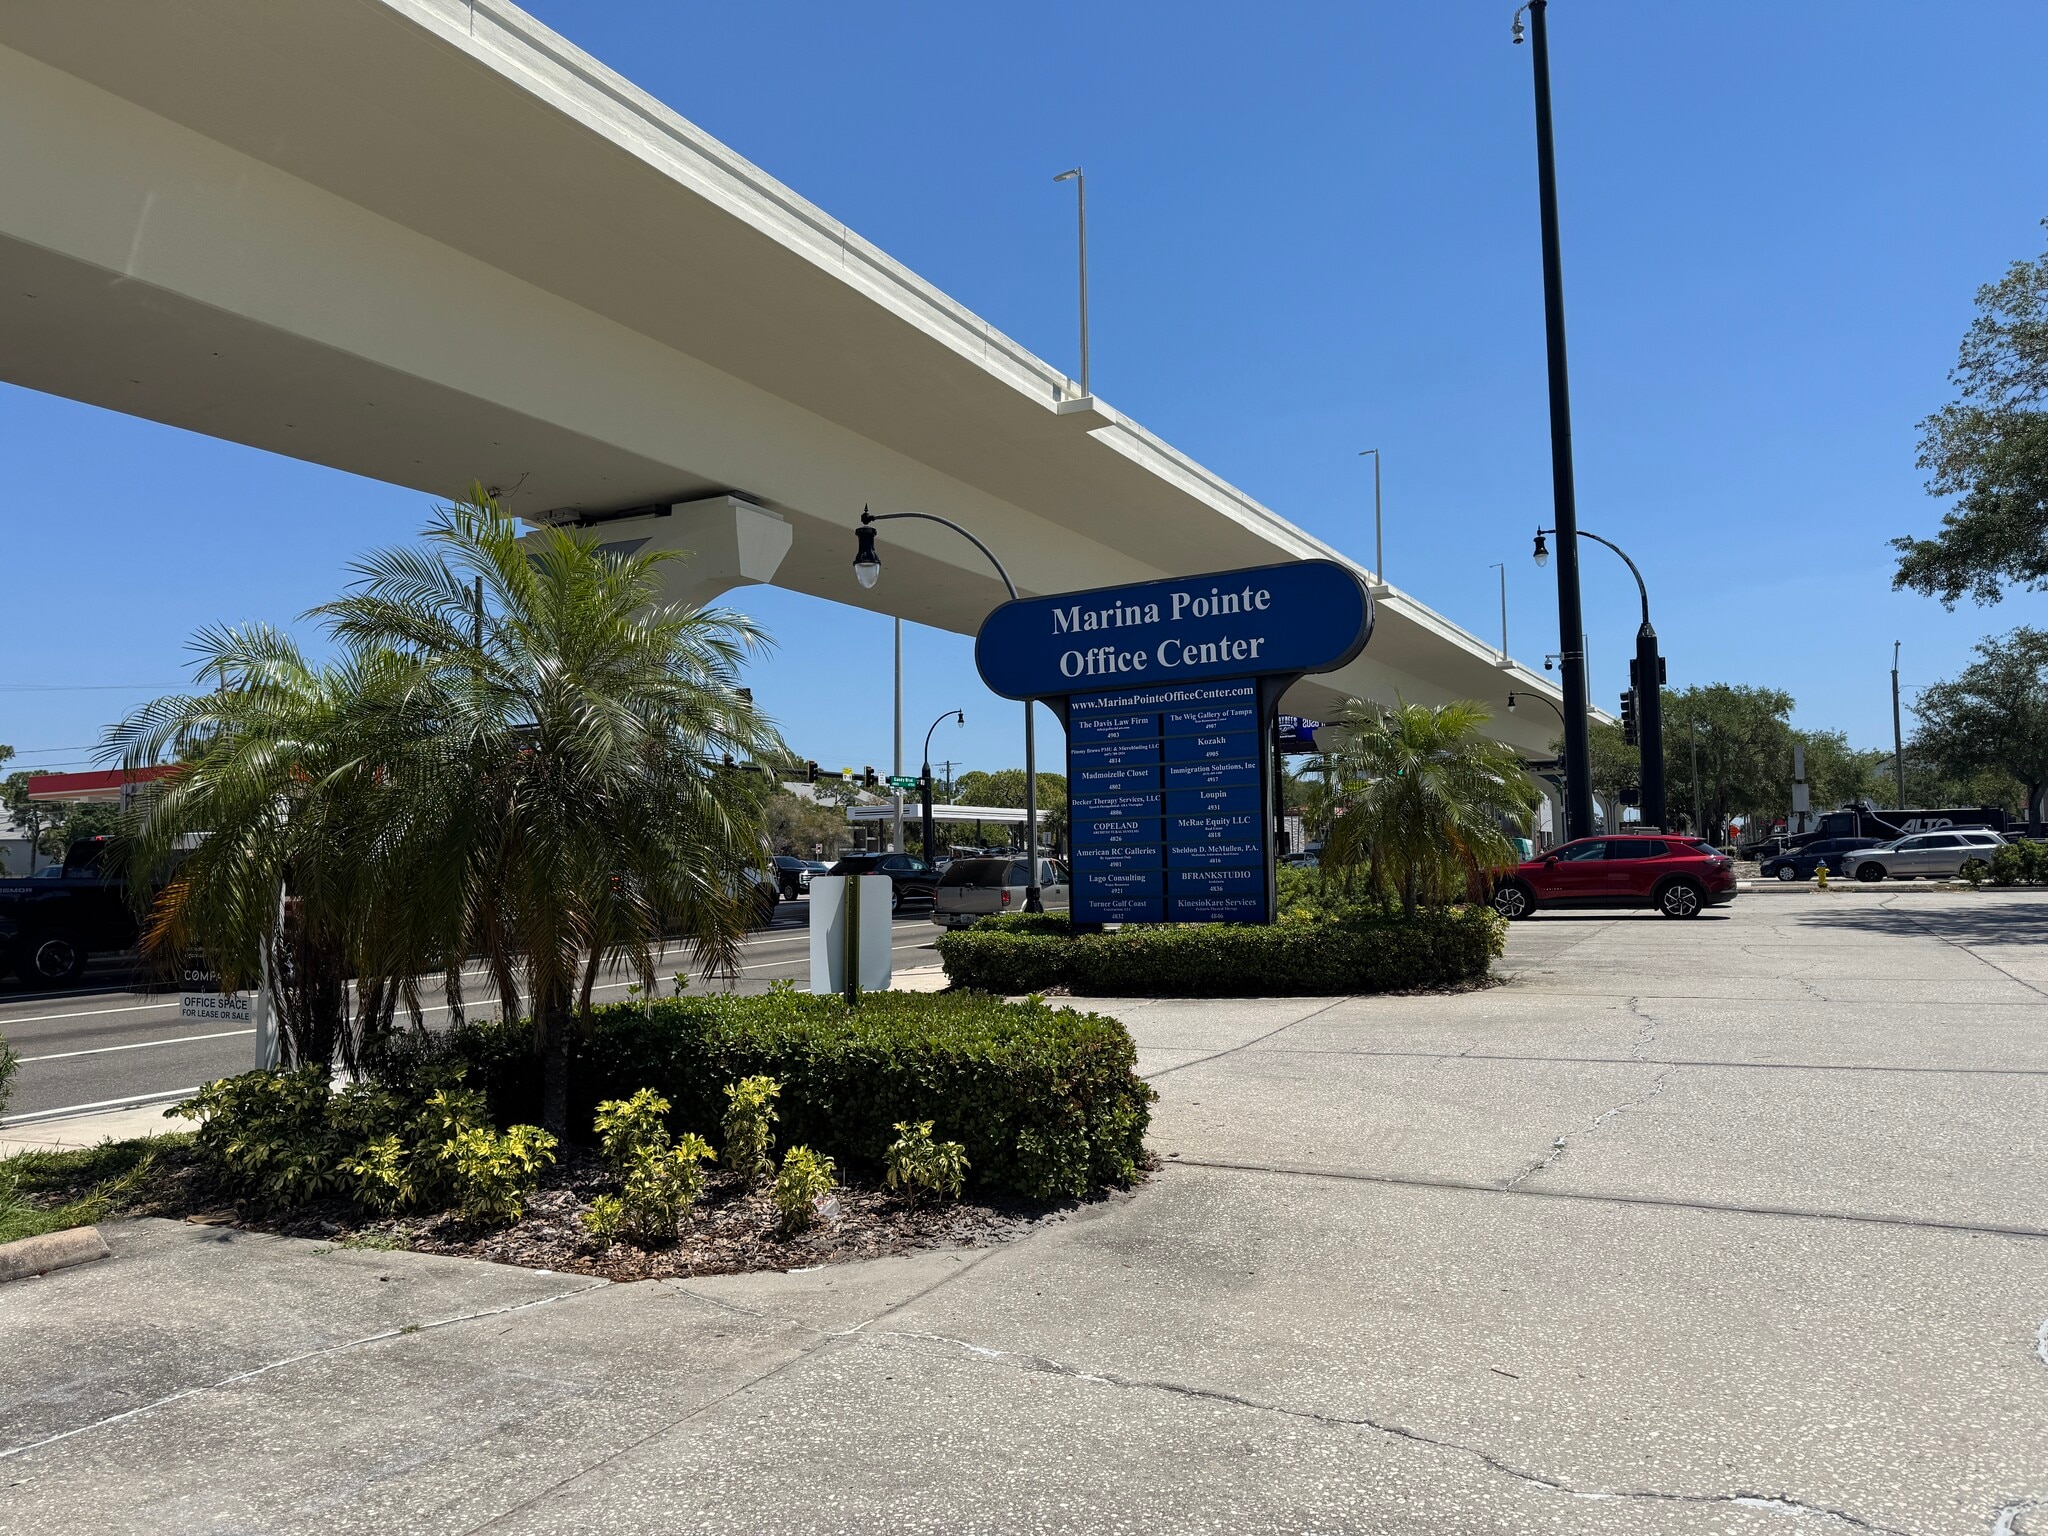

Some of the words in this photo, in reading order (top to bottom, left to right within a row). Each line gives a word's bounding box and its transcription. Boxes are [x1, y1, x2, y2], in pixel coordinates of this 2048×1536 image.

[1051, 600, 1160, 636] Marina
[1170, 585, 1271, 621] Pointe
[1060, 645, 1148, 678] Office
[1157, 636, 1264, 669] Center
[1072, 687, 1254, 710] www.MarinaPointeOfficeCenter.com
[1184, 713, 1196, 721] Wig
[1198, 711, 1221, 720] Gallery
[1230, 709, 1252, 717] Tampa
[1094, 720, 1112, 728] Davis
[1131, 717, 1148, 725] Firm
[1198, 737, 1225, 745] Kozakh
[1082, 771, 1125, 779] Madmoizelle
[1171, 766, 1210, 775] Immigration
[1201, 791, 1226, 799] Loupin
[1094, 797, 1118, 806] Therapy
[1119, 796, 1145, 804] Services,
[1093, 822, 1138, 831] COPELAND
[1179, 819, 1204, 827] McRae
[1206, 818, 1230, 826] Equity
[1232, 816, 1250, 824] LLC
[1896, 818, 1953, 834] ALTO
[1077, 849, 1110, 857] American
[1126, 847, 1155, 855] Galleries
[1209, 846, 1243, 854] McMullen,
[1089, 875, 1106, 883] Lago
[1108, 874, 1145, 882] Consulting
[1182, 871, 1250, 880] BFRANKSTUDIO
[184, 997, 216, 1008] OFFICE
[218, 999, 247, 1009] SPACE
[198, 1010, 218, 1018] LEASE
[221, 1011, 231, 1019] OR
[232, 1012, 249, 1020] SALE
